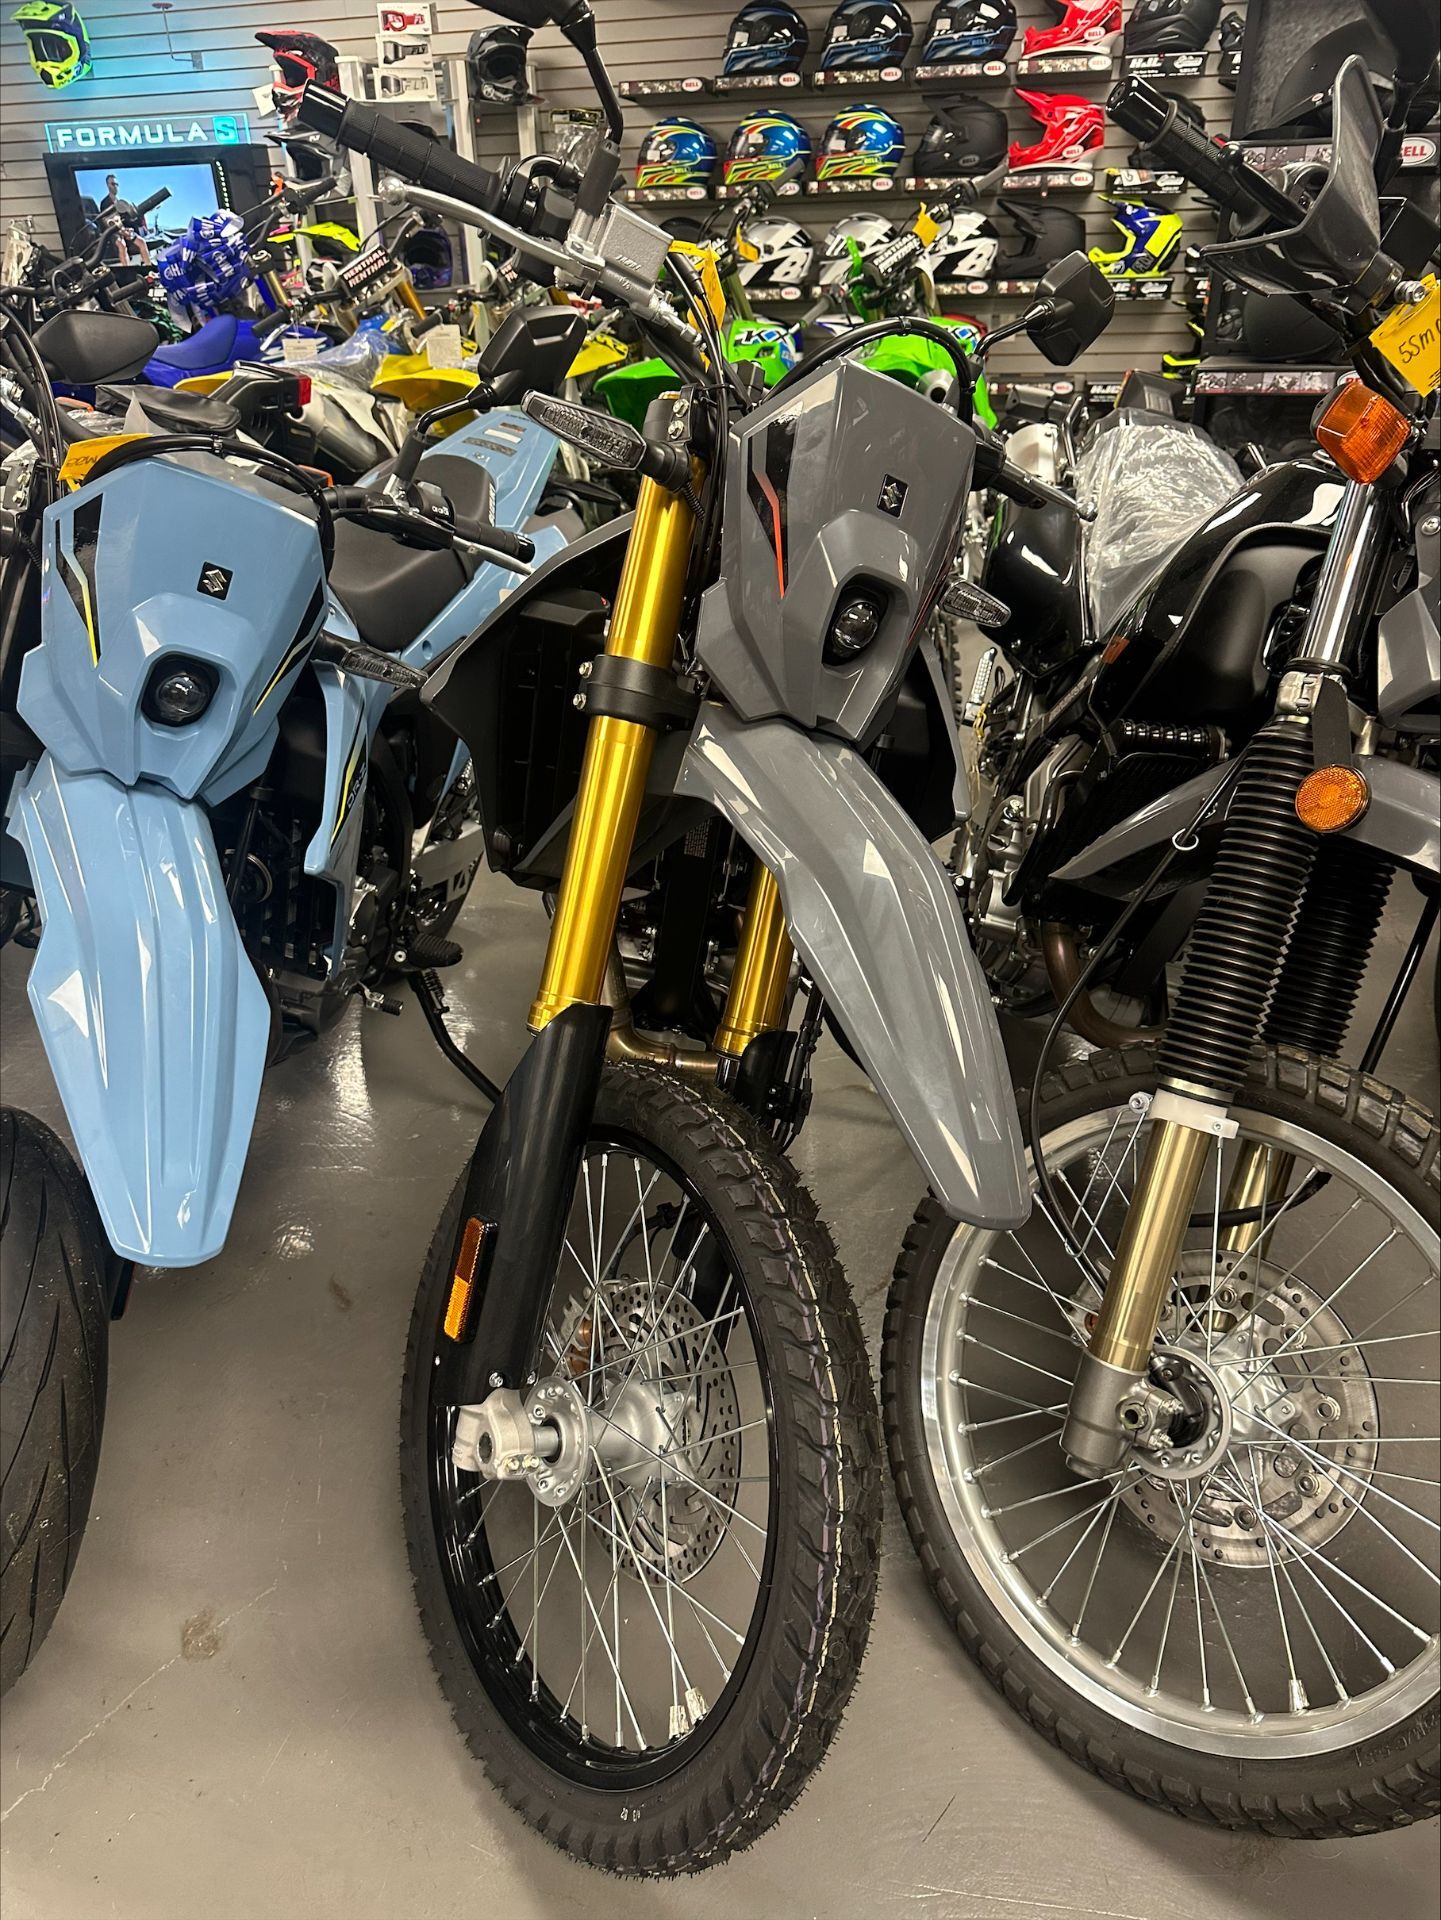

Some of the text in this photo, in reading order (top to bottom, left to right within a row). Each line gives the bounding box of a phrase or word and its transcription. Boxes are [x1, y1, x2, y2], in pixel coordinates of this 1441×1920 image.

[56, 119, 237, 148] FORMULA S
[1402, 145, 1427, 157] ELL
[343, 249, 386, 281] RENTHAL
[873, 233, 916, 266] RENTHAL
[348, 256, 390, 288] RENTHAL
